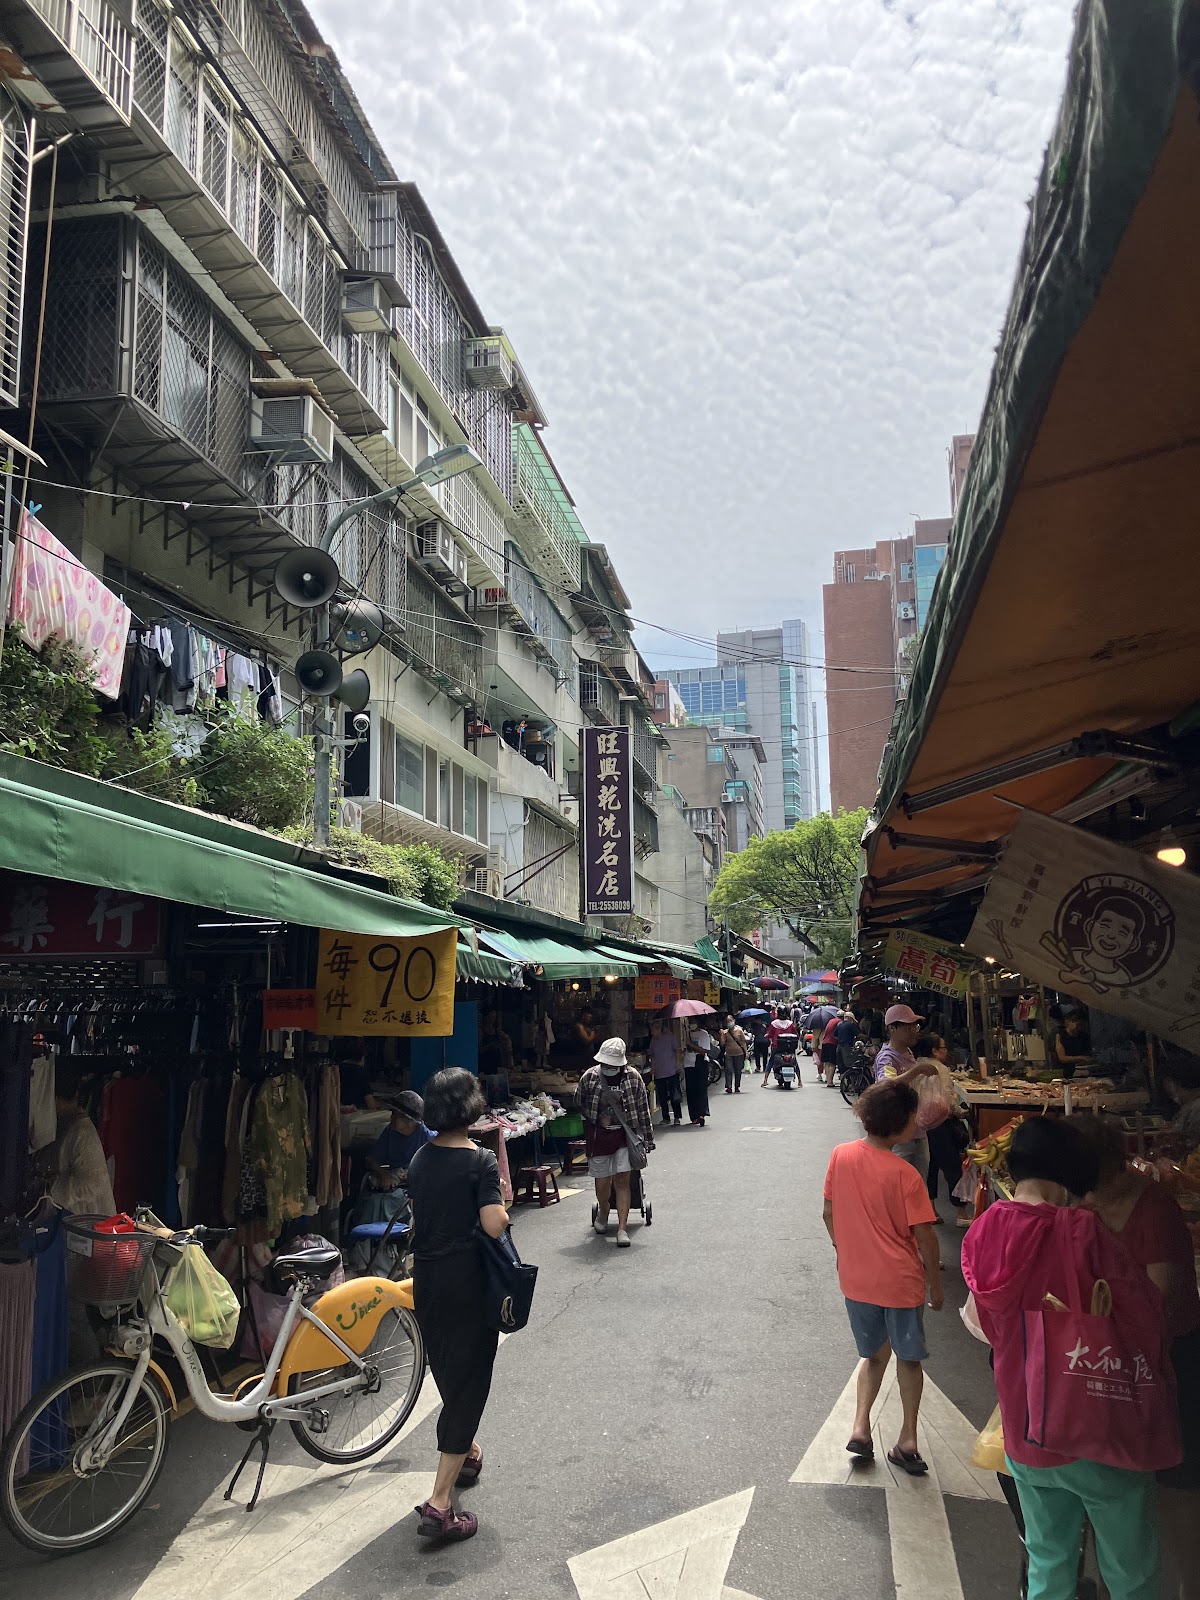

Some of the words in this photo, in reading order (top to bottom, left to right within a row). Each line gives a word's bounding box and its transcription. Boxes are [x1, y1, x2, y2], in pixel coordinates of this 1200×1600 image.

[595, 732, 622, 896] 旺興乾洗名店
[1097, 877, 1112, 886] YI
[1123, 880, 1164, 910] SIANG
[323, 938, 359, 1020] 每件
[368, 943, 436, 1008] 90
[896, 945, 960, 986] 蘆筍
[362, 1009, 432, 1025] 恕不退換
